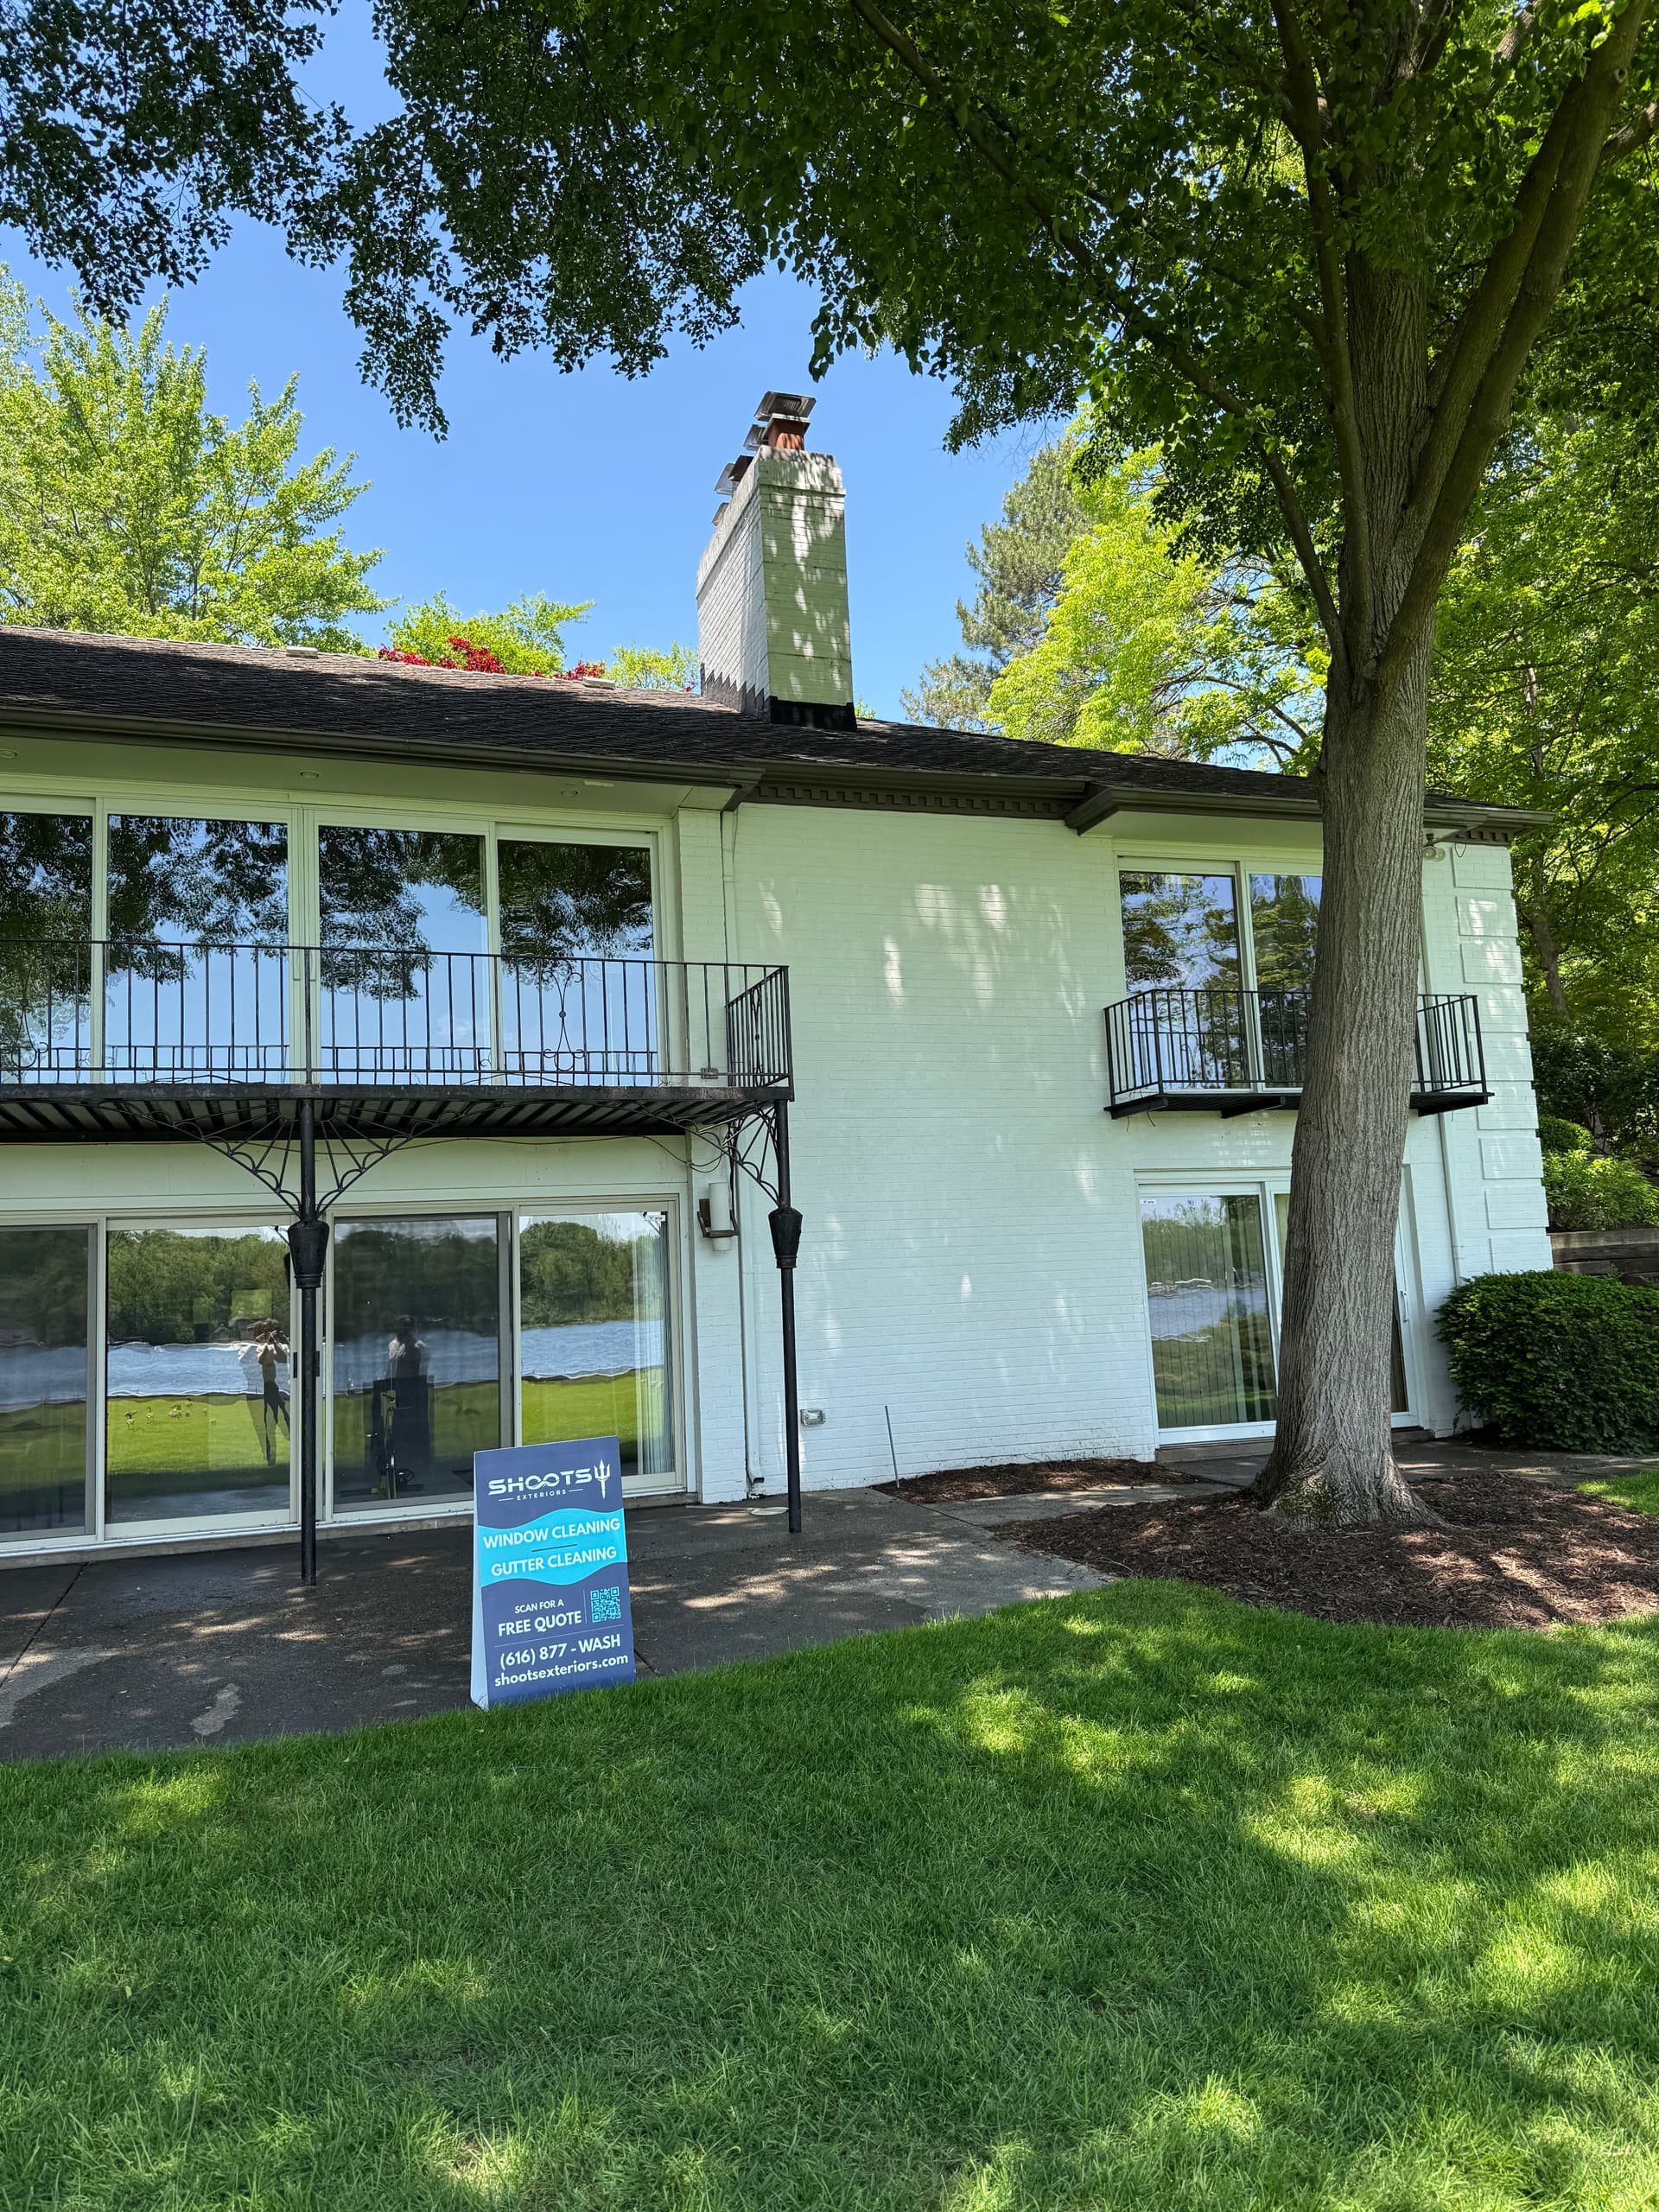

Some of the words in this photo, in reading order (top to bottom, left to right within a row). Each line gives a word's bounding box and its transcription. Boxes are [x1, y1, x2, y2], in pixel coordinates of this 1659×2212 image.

[488, 1468, 593, 1496] SHOOTS
[517, 1489, 567, 1501] EXTERIORS
[483, 1528, 549, 1549] WINDOW
[551, 1517, 620, 1538] CLEANING
[491, 1557, 545, 1577] GUTTER
[547, 1546, 617, 1567] CLEANING
[514, 1603, 537, 1614] SCAN
[539, 1600, 556, 1610] FOR
[498, 1619, 531, 1637] FREE
[534, 1611, 582, 1632] QUOTE
[500, 1648, 536, 1670] (616)
[539, 1643, 568, 1661] 877
[578, 1633, 621, 1653] WASH
[494, 1655, 629, 1687] shootsexteriors.com
